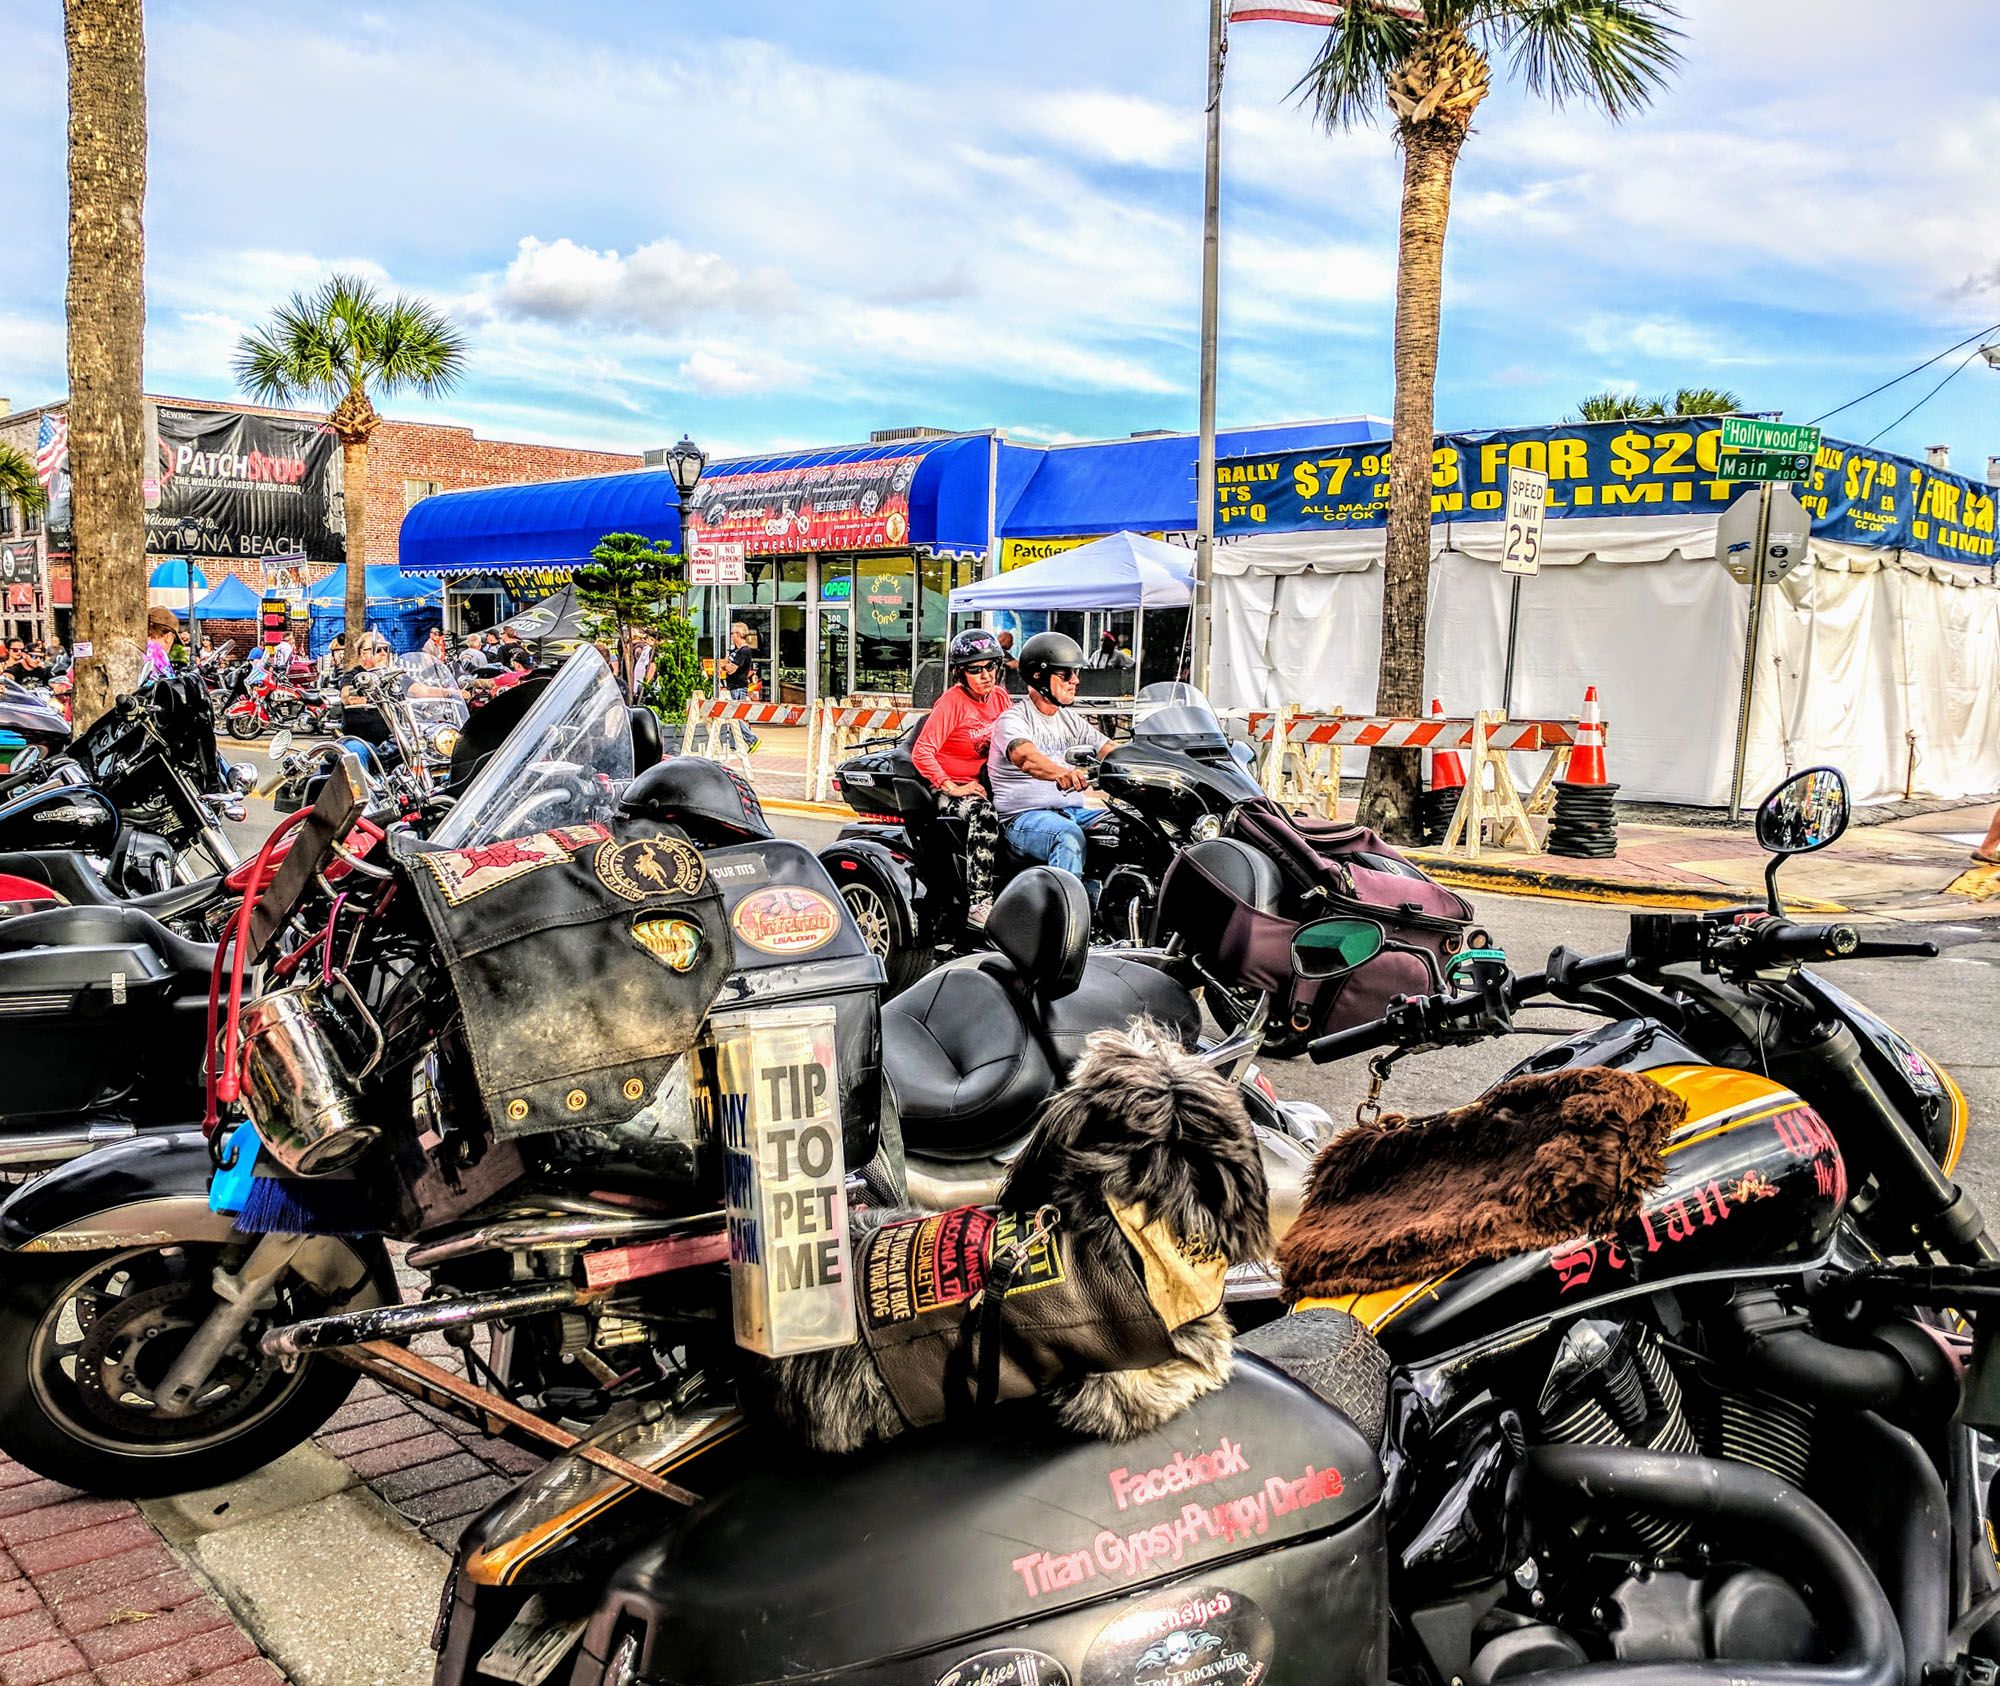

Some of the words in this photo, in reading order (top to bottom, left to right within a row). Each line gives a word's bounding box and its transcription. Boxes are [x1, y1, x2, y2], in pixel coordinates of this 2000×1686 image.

[1725, 420, 1732, 431] S
[1730, 421, 1797, 448] Hollywood
[1800, 428, 1809, 438] Av
[1481, 438, 1589, 484] FOR
[1723, 459, 1767, 476] Main
[1781, 456, 1792, 465] St
[175, 476, 190, 486] THE
[191, 477, 222, 487] WORLDS
[223, 479, 254, 490] LARGEST
[255, 482, 278, 492] PATCH
[1217, 463, 1280, 484] RALLY
[1776, 470, 1797, 480] 400
[1814, 446, 1844, 471] ALLY
[1845, 456, 1896, 500] $7.99
[1217, 485, 1252, 503] T'S
[1512, 482, 1543, 499] SPEED
[1301, 505, 1335, 514] ALL
[1431, 491, 1503, 513] NO
[1513, 506, 1538, 519] LIMIT
[1881, 495, 1895, 511] EA
[1218, 506, 1247, 523] 1ST
[1250, 504, 1267, 522] Q
[1323, 512, 1348, 522] CC
[1350, 511, 1375, 520] OK
[1847, 508, 1862, 519] ALL
[1863, 512, 1898, 524] MAJOR
[1855, 520, 1868, 530] CC
[1869, 522, 1886, 532] OK
[146, 530, 232, 553] AYTNA
[240, 535, 303, 555] BEACH
[725, 546, 736, 554] NO
[734, 533, 883, 553] keweekjewelry.com
[1506, 523, 1538, 563] 25
[719, 555, 742, 563] PARKING
[824, 581, 850, 596] OPEN
[871, 574, 901, 593] OFFICIAL
[827, 615, 841, 623] 500
[871, 609, 898, 625] COINS
[599, 844, 617, 876] DRAGON
[673, 854, 687, 885] CURVES
[710, 866, 735, 879] OUR
[735, 863, 756, 876] TITS
[614, 864, 639, 889] MILES
[688, 868, 700, 890] GAP
[773, 933, 817, 944] USA.com
[761, 1062, 827, 1122] TIP
[721, 1093, 748, 1148] MY
[767, 1125, 833, 1182] TO
[772, 1185, 838, 1238] PET
[729, 1216, 760, 1265] BANK
[941, 1212, 963, 1275] LACONIA
[775, 1238, 842, 1292] ME
[889, 1239, 910, 1272] TOUCH
[869, 1260, 888, 1292] YOUR
[888, 1272, 907, 1289] MY
[963, 1246, 983, 1293] MINE
[870, 1290, 891, 1318] DOG
[889, 1288, 912, 1320] BIKE
[1109, 1436, 1249, 1511] Facebook
[1012, 1549, 1096, 1599] Titan
[1264, 1465, 1345, 1517] Drake
[1183, 1653, 1249, 1682] ROCKWEAR
